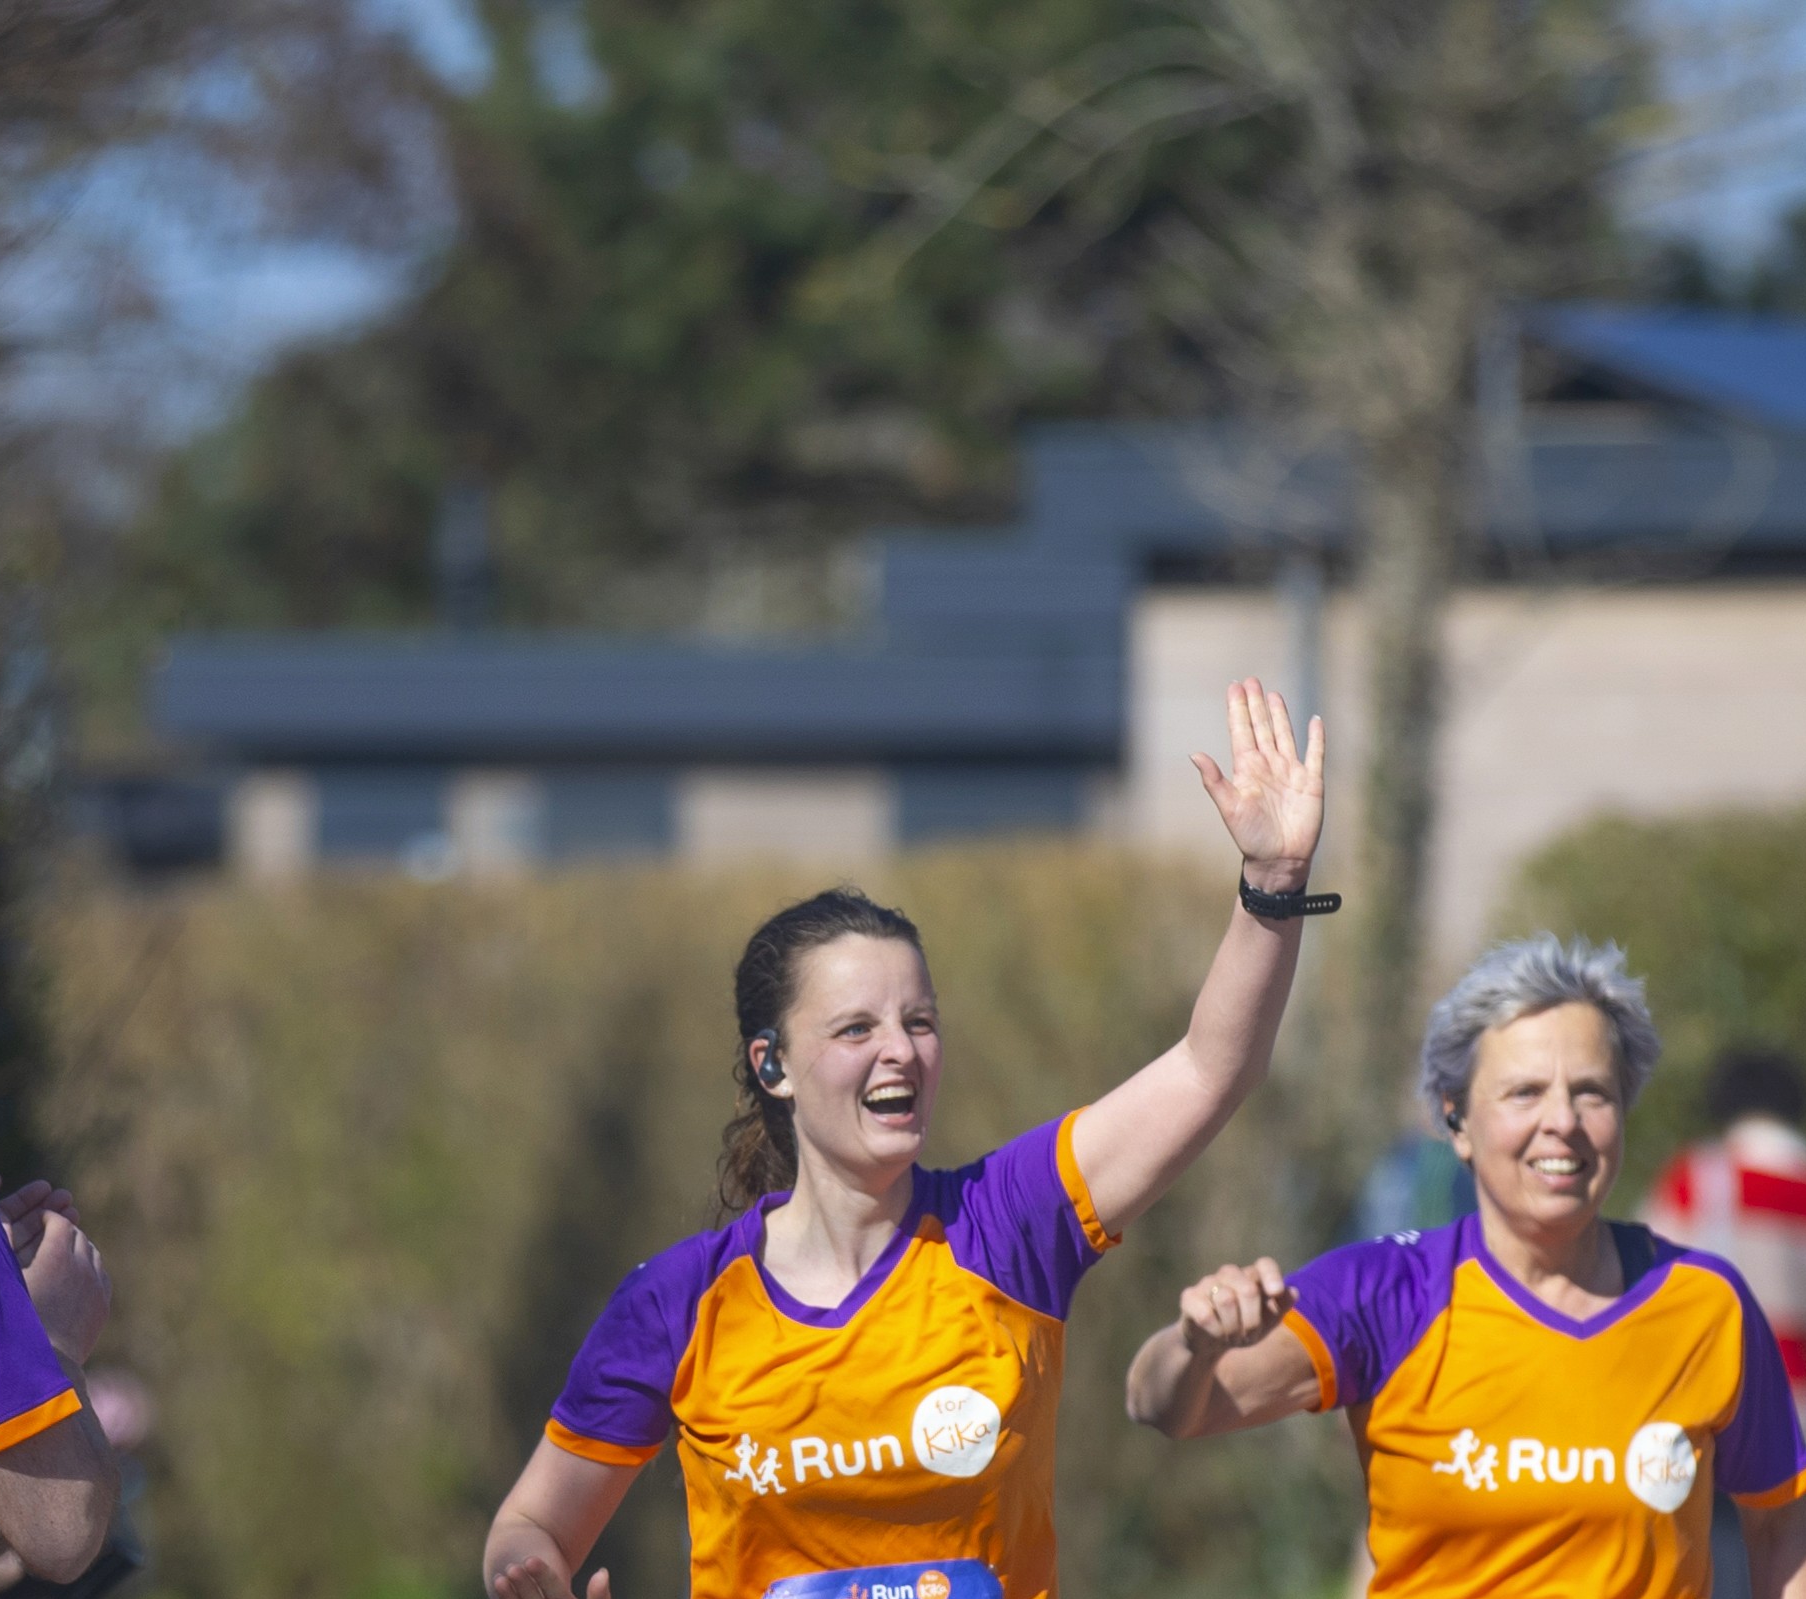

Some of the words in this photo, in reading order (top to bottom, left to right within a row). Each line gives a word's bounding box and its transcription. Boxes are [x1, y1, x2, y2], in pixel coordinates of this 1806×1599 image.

[934, 1398, 967, 1414] for
[790, 1434, 904, 1483] Run
[922, 1421, 991, 1461] KiKa
[1507, 1438, 1615, 1483] Run
